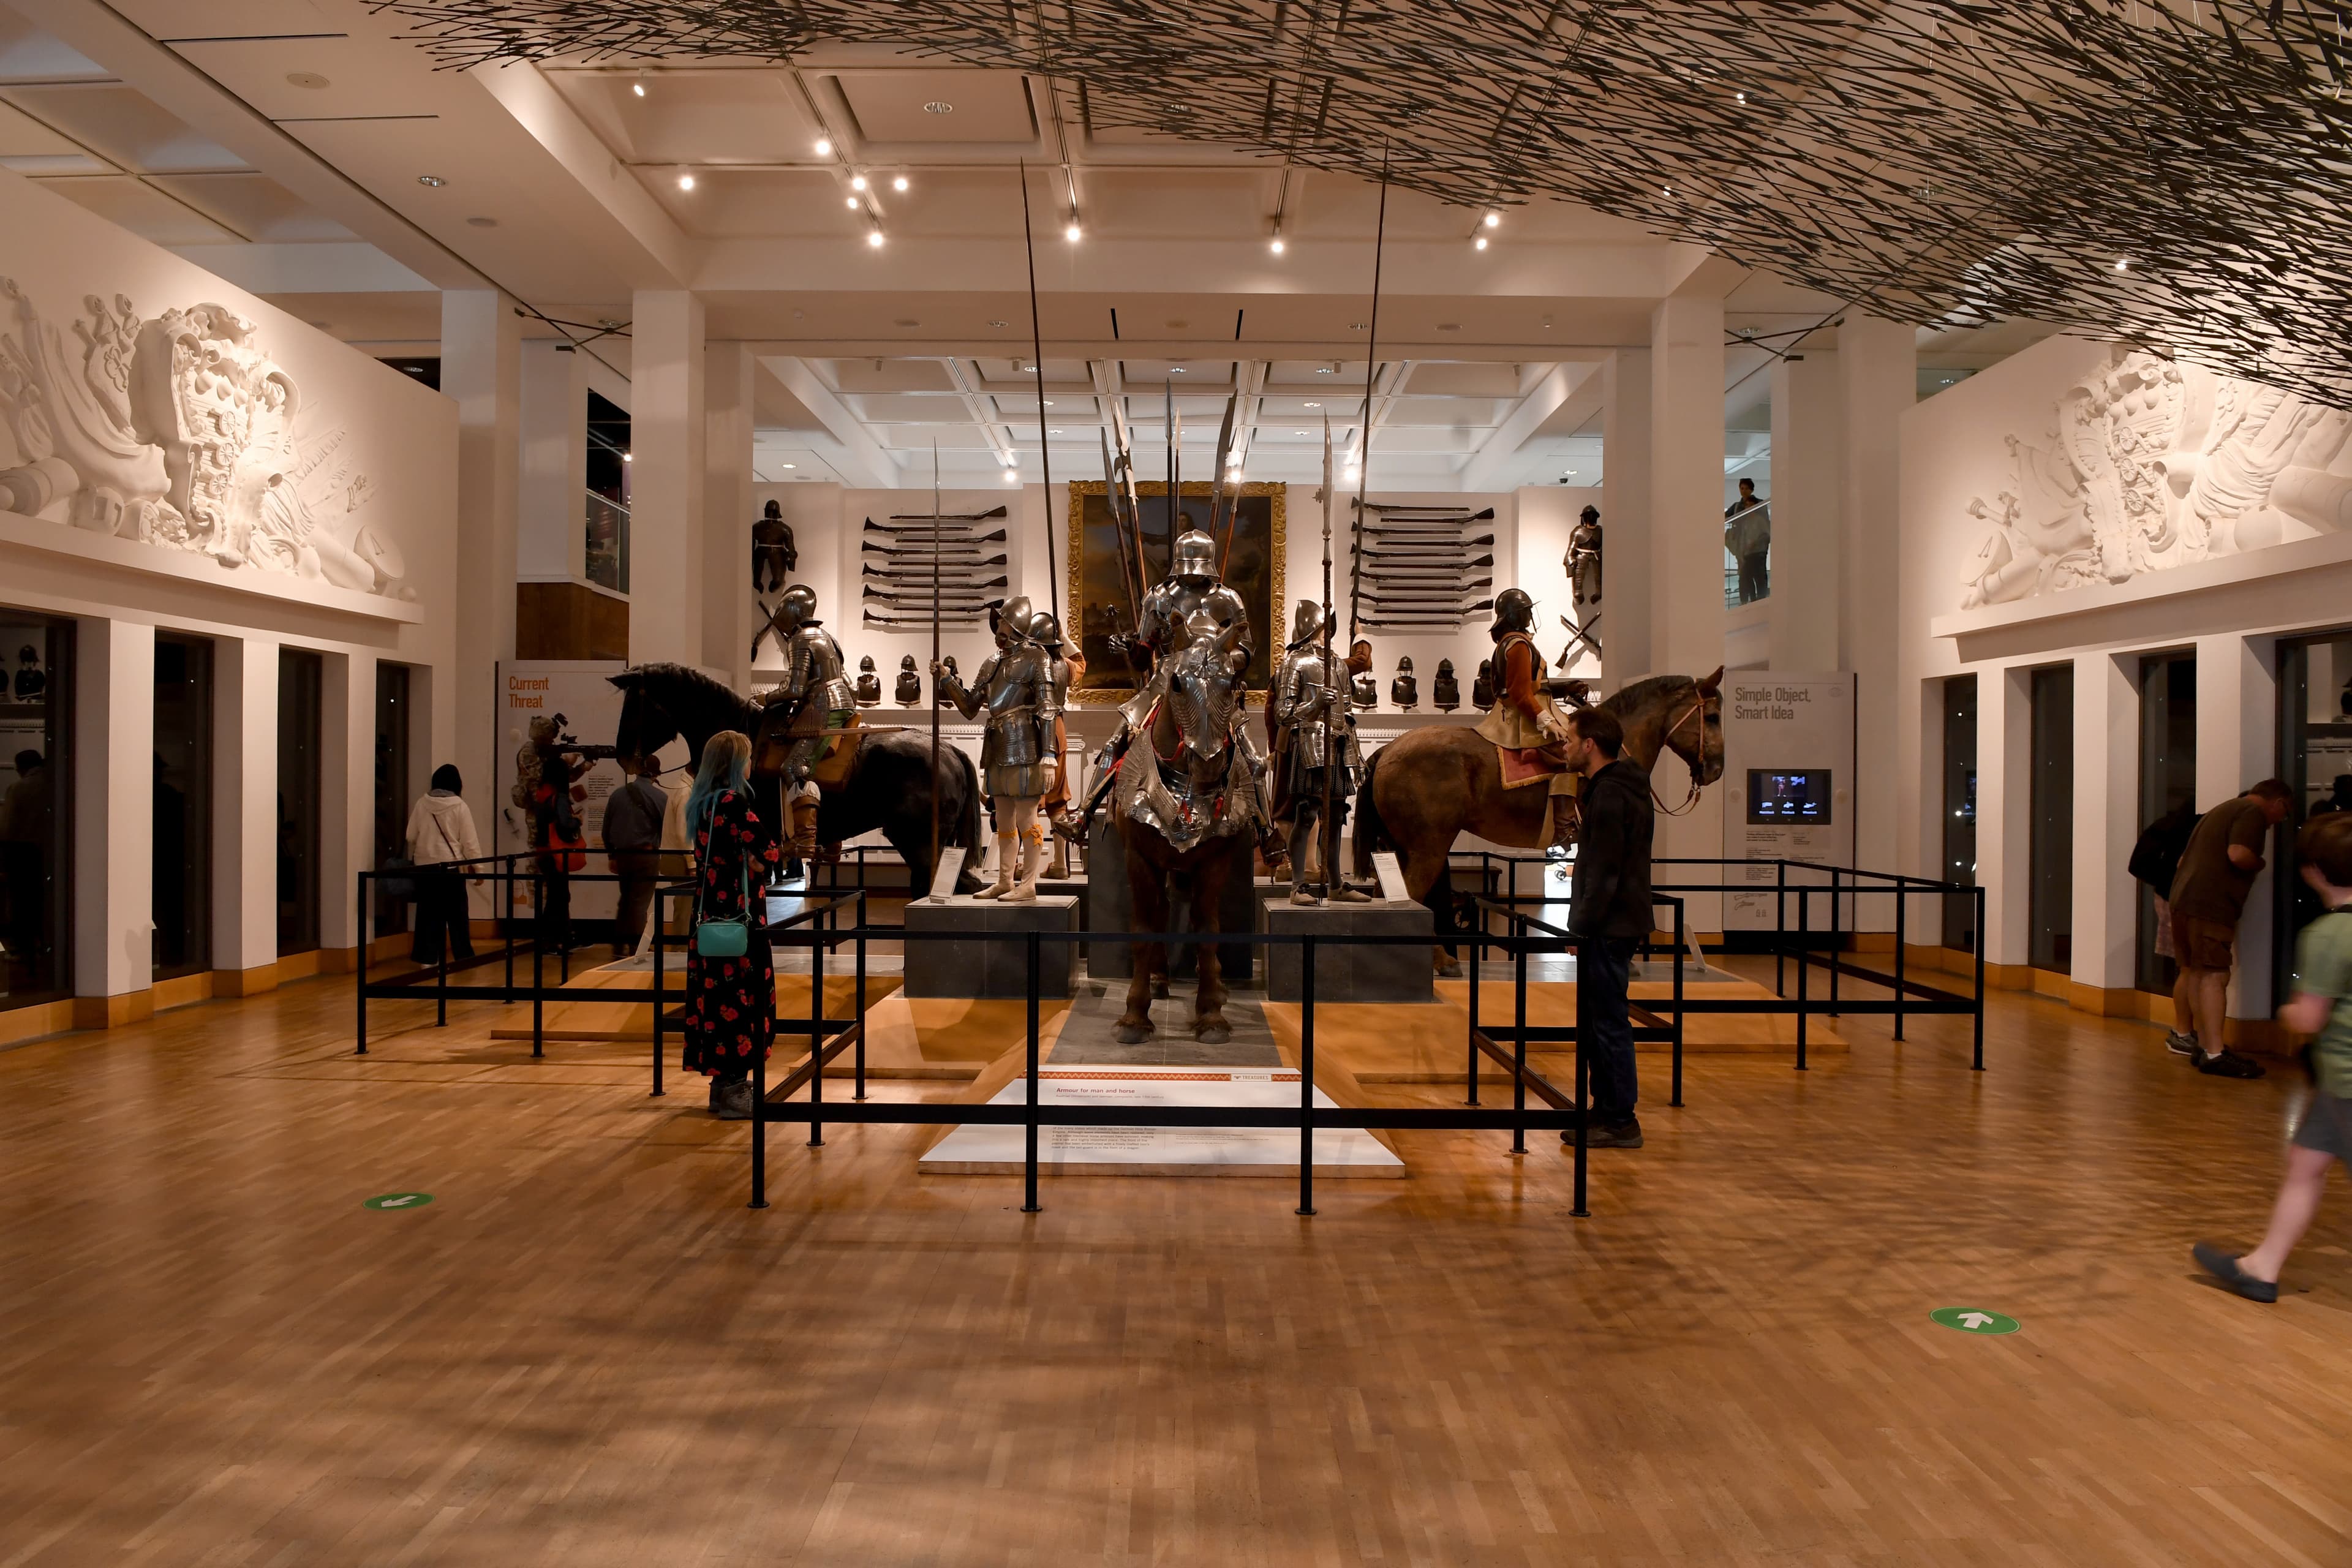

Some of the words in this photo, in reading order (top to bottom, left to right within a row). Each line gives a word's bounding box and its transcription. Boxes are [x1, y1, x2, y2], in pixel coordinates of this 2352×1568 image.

[509, 676, 549, 690] Current
[508, 693, 543, 708] Threat
[1735, 687, 1772, 705] Simple
[1776, 687, 1811, 705] Object,
[1735, 705, 1768, 720] Smart
[1771, 705, 1794, 720] Idea
